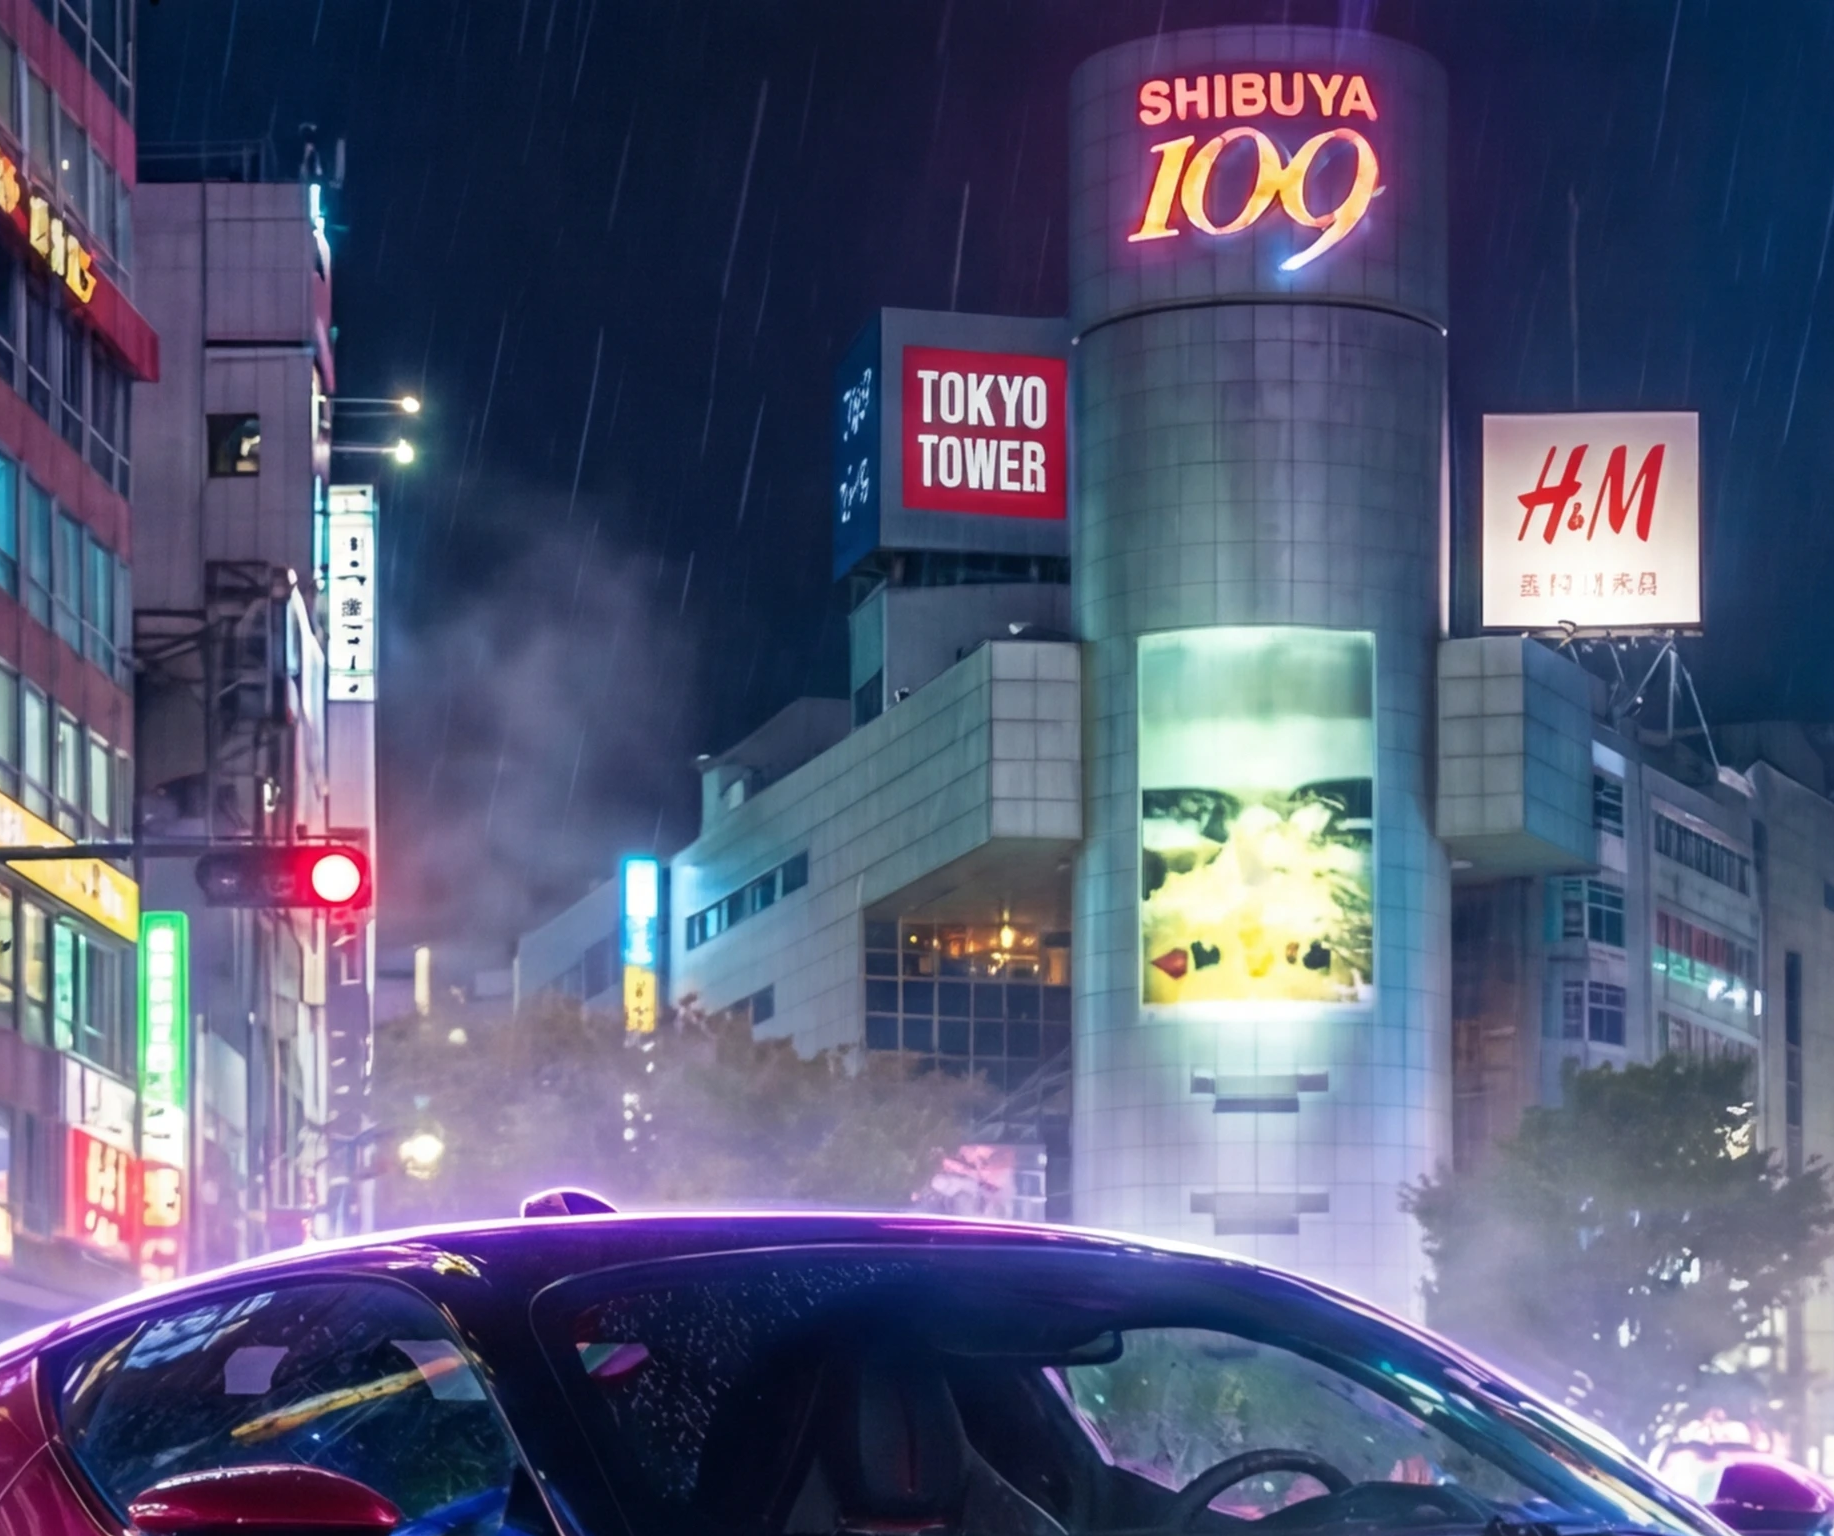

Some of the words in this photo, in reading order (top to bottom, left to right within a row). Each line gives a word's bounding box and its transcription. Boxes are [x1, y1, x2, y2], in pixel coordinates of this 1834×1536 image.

[1139, 72, 1378, 125] SHIBUYA
[1127, 126, 1380, 271] 109
[917, 370, 1047, 429] TOKYO
[917, 434, 1046, 492] TOWER
[1517, 443, 1666, 545] H&M
